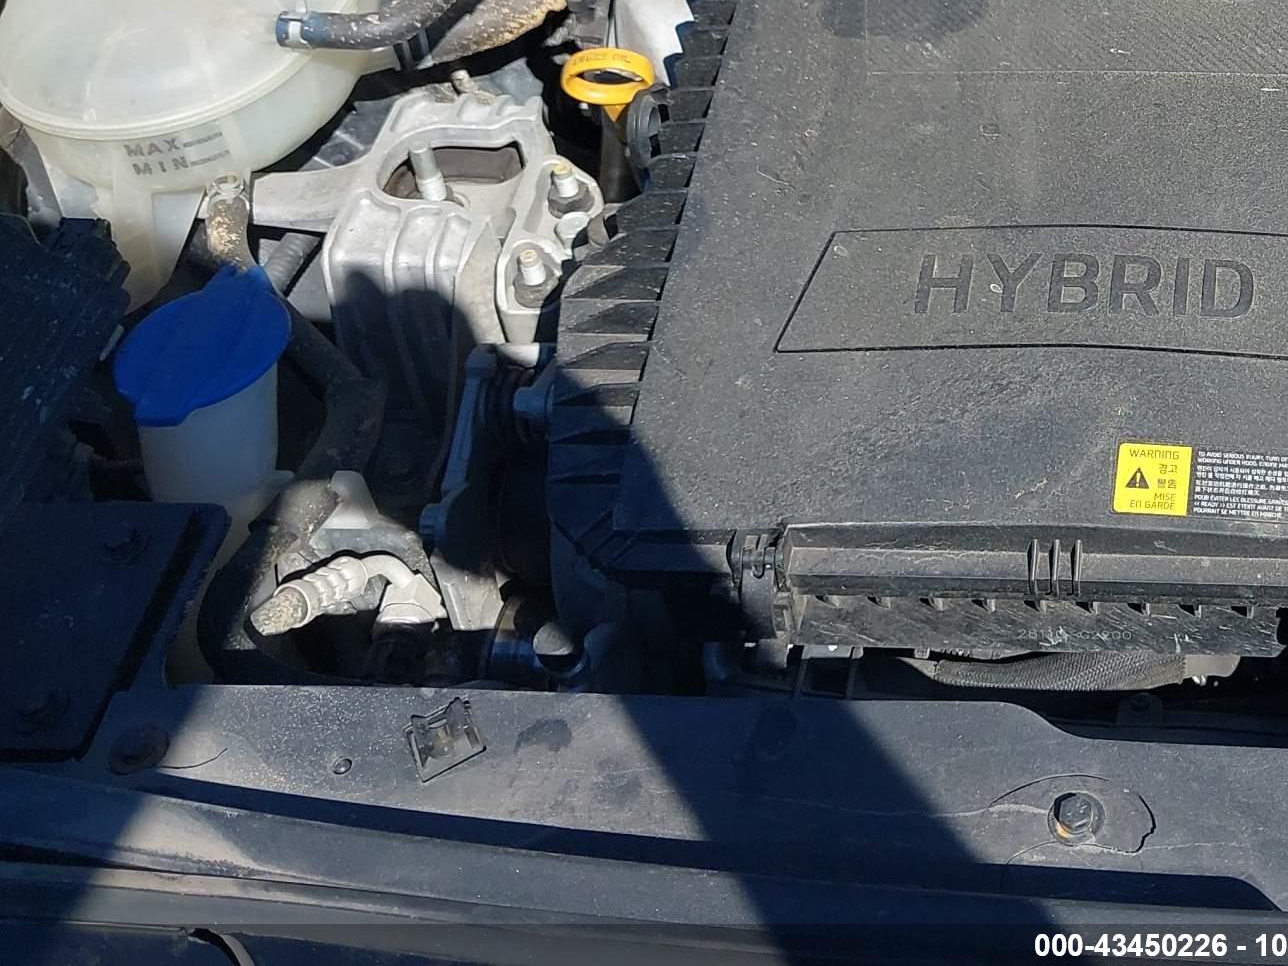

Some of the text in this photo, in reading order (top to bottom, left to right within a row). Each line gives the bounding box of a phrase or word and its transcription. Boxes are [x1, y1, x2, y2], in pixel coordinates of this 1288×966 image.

[123, 137, 181, 157] MAX
[132, 156, 190, 176] MIN
[911, 251, 1256, 319] HYBRID
[1129, 448, 1180, 460] WARNING
[1129, 499, 1176, 511] EN GARDE
[1153, 492, 1177, 502] MISE
